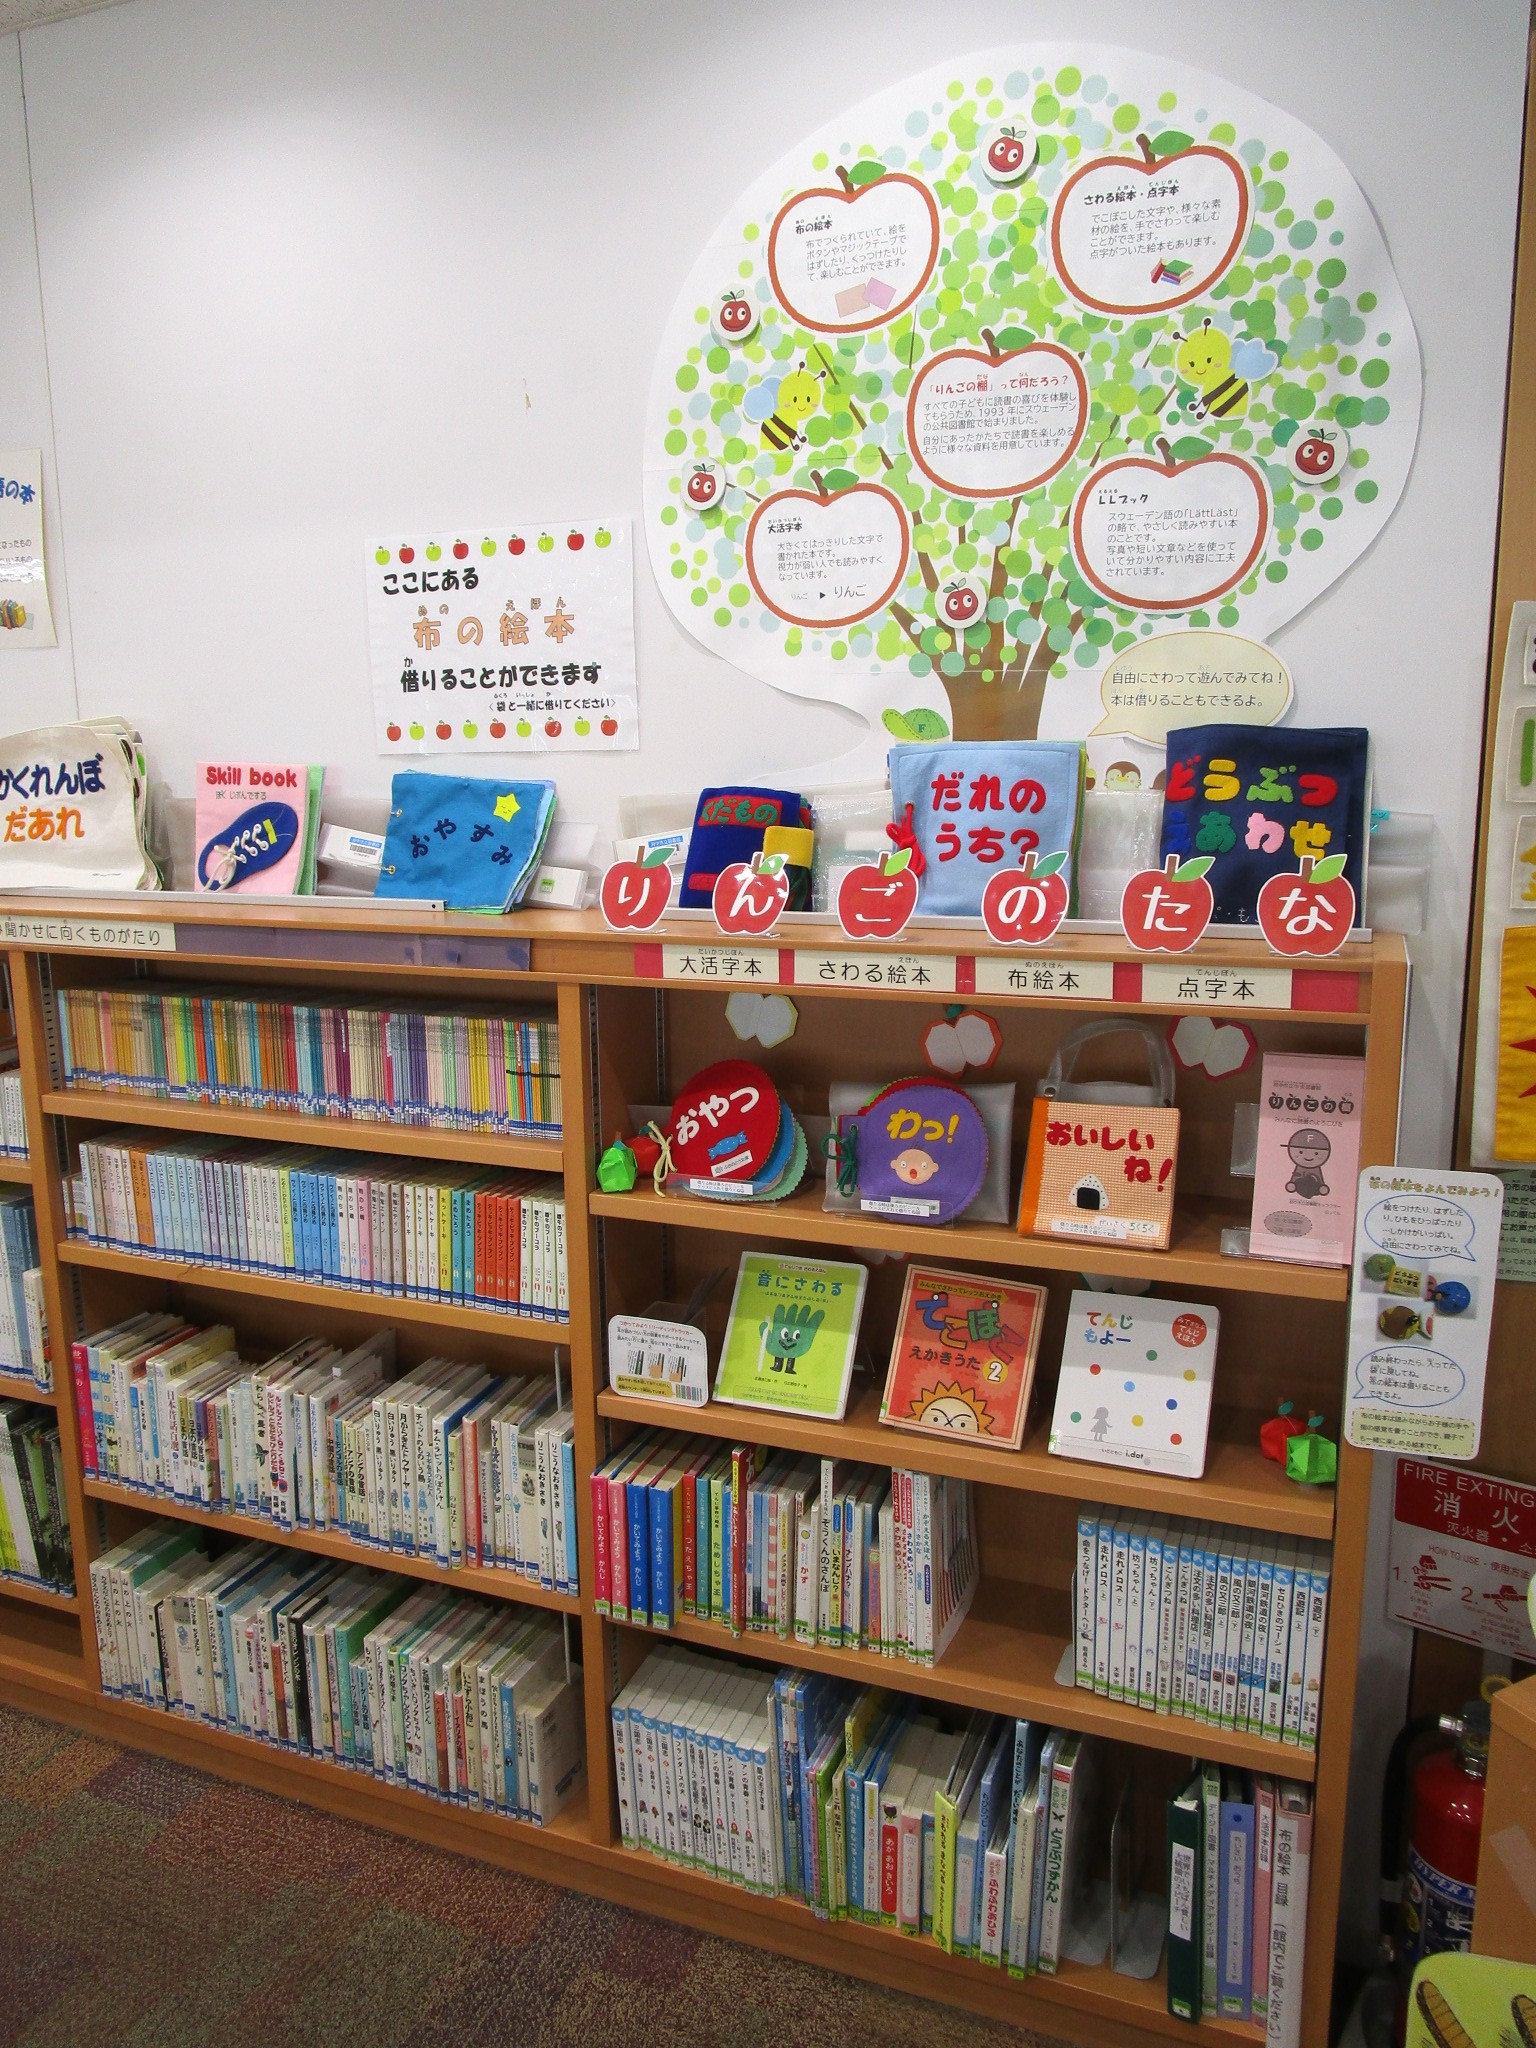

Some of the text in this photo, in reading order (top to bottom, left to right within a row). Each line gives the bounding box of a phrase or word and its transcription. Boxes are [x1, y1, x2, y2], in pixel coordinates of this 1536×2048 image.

[1084, 185, 1179, 205] さわる絵本・点字本
[1091, 211, 1220, 235] 材の絵を、手でさわって楽しむ
[1092, 198, 1221, 224] でこぼこした文字や、様々な素
[796, 219, 832, 235] 布の絵本
[806, 224, 906, 249] 布でつくられていて、絵を
[1091, 232, 1158, 247] ことができます。
[807, 235, 907, 260] ボタンやマジックテープで
[807, 246, 907, 271] はずしたり、くっつけたりし
[1090, 235, 1216, 260] 点字がついた絵本もあります。
[808, 258, 906, 281] て、楽しむことができます。
[924, 392, 1077, 411] すべての子どもに読書の喜びを体験し
[924, 402, 1077, 421] てもらうため、 1993 年にスウェーデン
[923, 415, 1038, 431] の公共図書館で始まりました。
[922, 438, 1065, 456] ように様々な資料を用意しています。
[923, 427, 1075, 446] 自分にあったかたちで読書を楽しめる
[767, 522, 802, 534] 大活字本
[1107, 519, 1238, 533] の略で、やさしく読みやすい本
[1107, 533, 1157, 543] のことです。
[778, 535, 883, 551] 大きくてはっきりした文字で
[778, 549, 836, 561] 書かれた本です。
[1107, 541, 1236, 555] 写真や短い文章などを使って
[778, 555, 883, 572] 視力が弱い人でも読みやすく
[1106, 553, 1236, 566] いて分かりやすい内容に工夫
[1106, 566, 1165, 578] されています。
[382, 566, 479, 596] ここにある
[778, 570, 828, 581] なっています。
[790, 584, 866, 600] りんご りんご
[412, 608, 575, 651] 布の絵本
[400, 662, 602, 693] 借りることができます
[1111, 694, 1263, 707] 本は借りることもできるよ。
[0, 753, 106, 800] かくれんぼ
[206, 766, 298, 788] Skill book
[1165, 755, 1338, 807] どうぶつ
[930, 771, 1048, 814] だれの
[4, 805, 85, 843] だあれ
[701, 798, 778, 825] くだもの
[410, 817, 514, 866] おやすみ
[617, 877, 650, 916] り
[729, 876, 775, 918] ん
[855, 882, 903, 922] ご
[998, 886, 1047, 924] の
[1142, 886, 1191, 932] た
[1278, 887, 1337, 935] な
[680, 955, 761, 977] 大活字本
[818, 960, 931, 986] さわる絵本
[1007, 969, 1080, 991] 布絵本
[1178, 977, 1255, 1000] 点字本
[676, 1086, 760, 1146] おやつ
[1047, 1121, 1155, 1151] おいしい
[758, 1269, 843, 1296] 音にさわる
[1086, 1311, 1133, 1330] てんじ
[1084, 1328, 1131, 1345] もよー
[909, 1346, 1003, 1382] えかきうた 2
[1403, 1463, 1536, 1507] FIRE EXTING
[1434, 1489, 1520, 1535] 消 火
[820, 1518, 831, 1593] ぞうくんのさんぽ
[1277, 1829, 1293, 1877] 布の絵本
